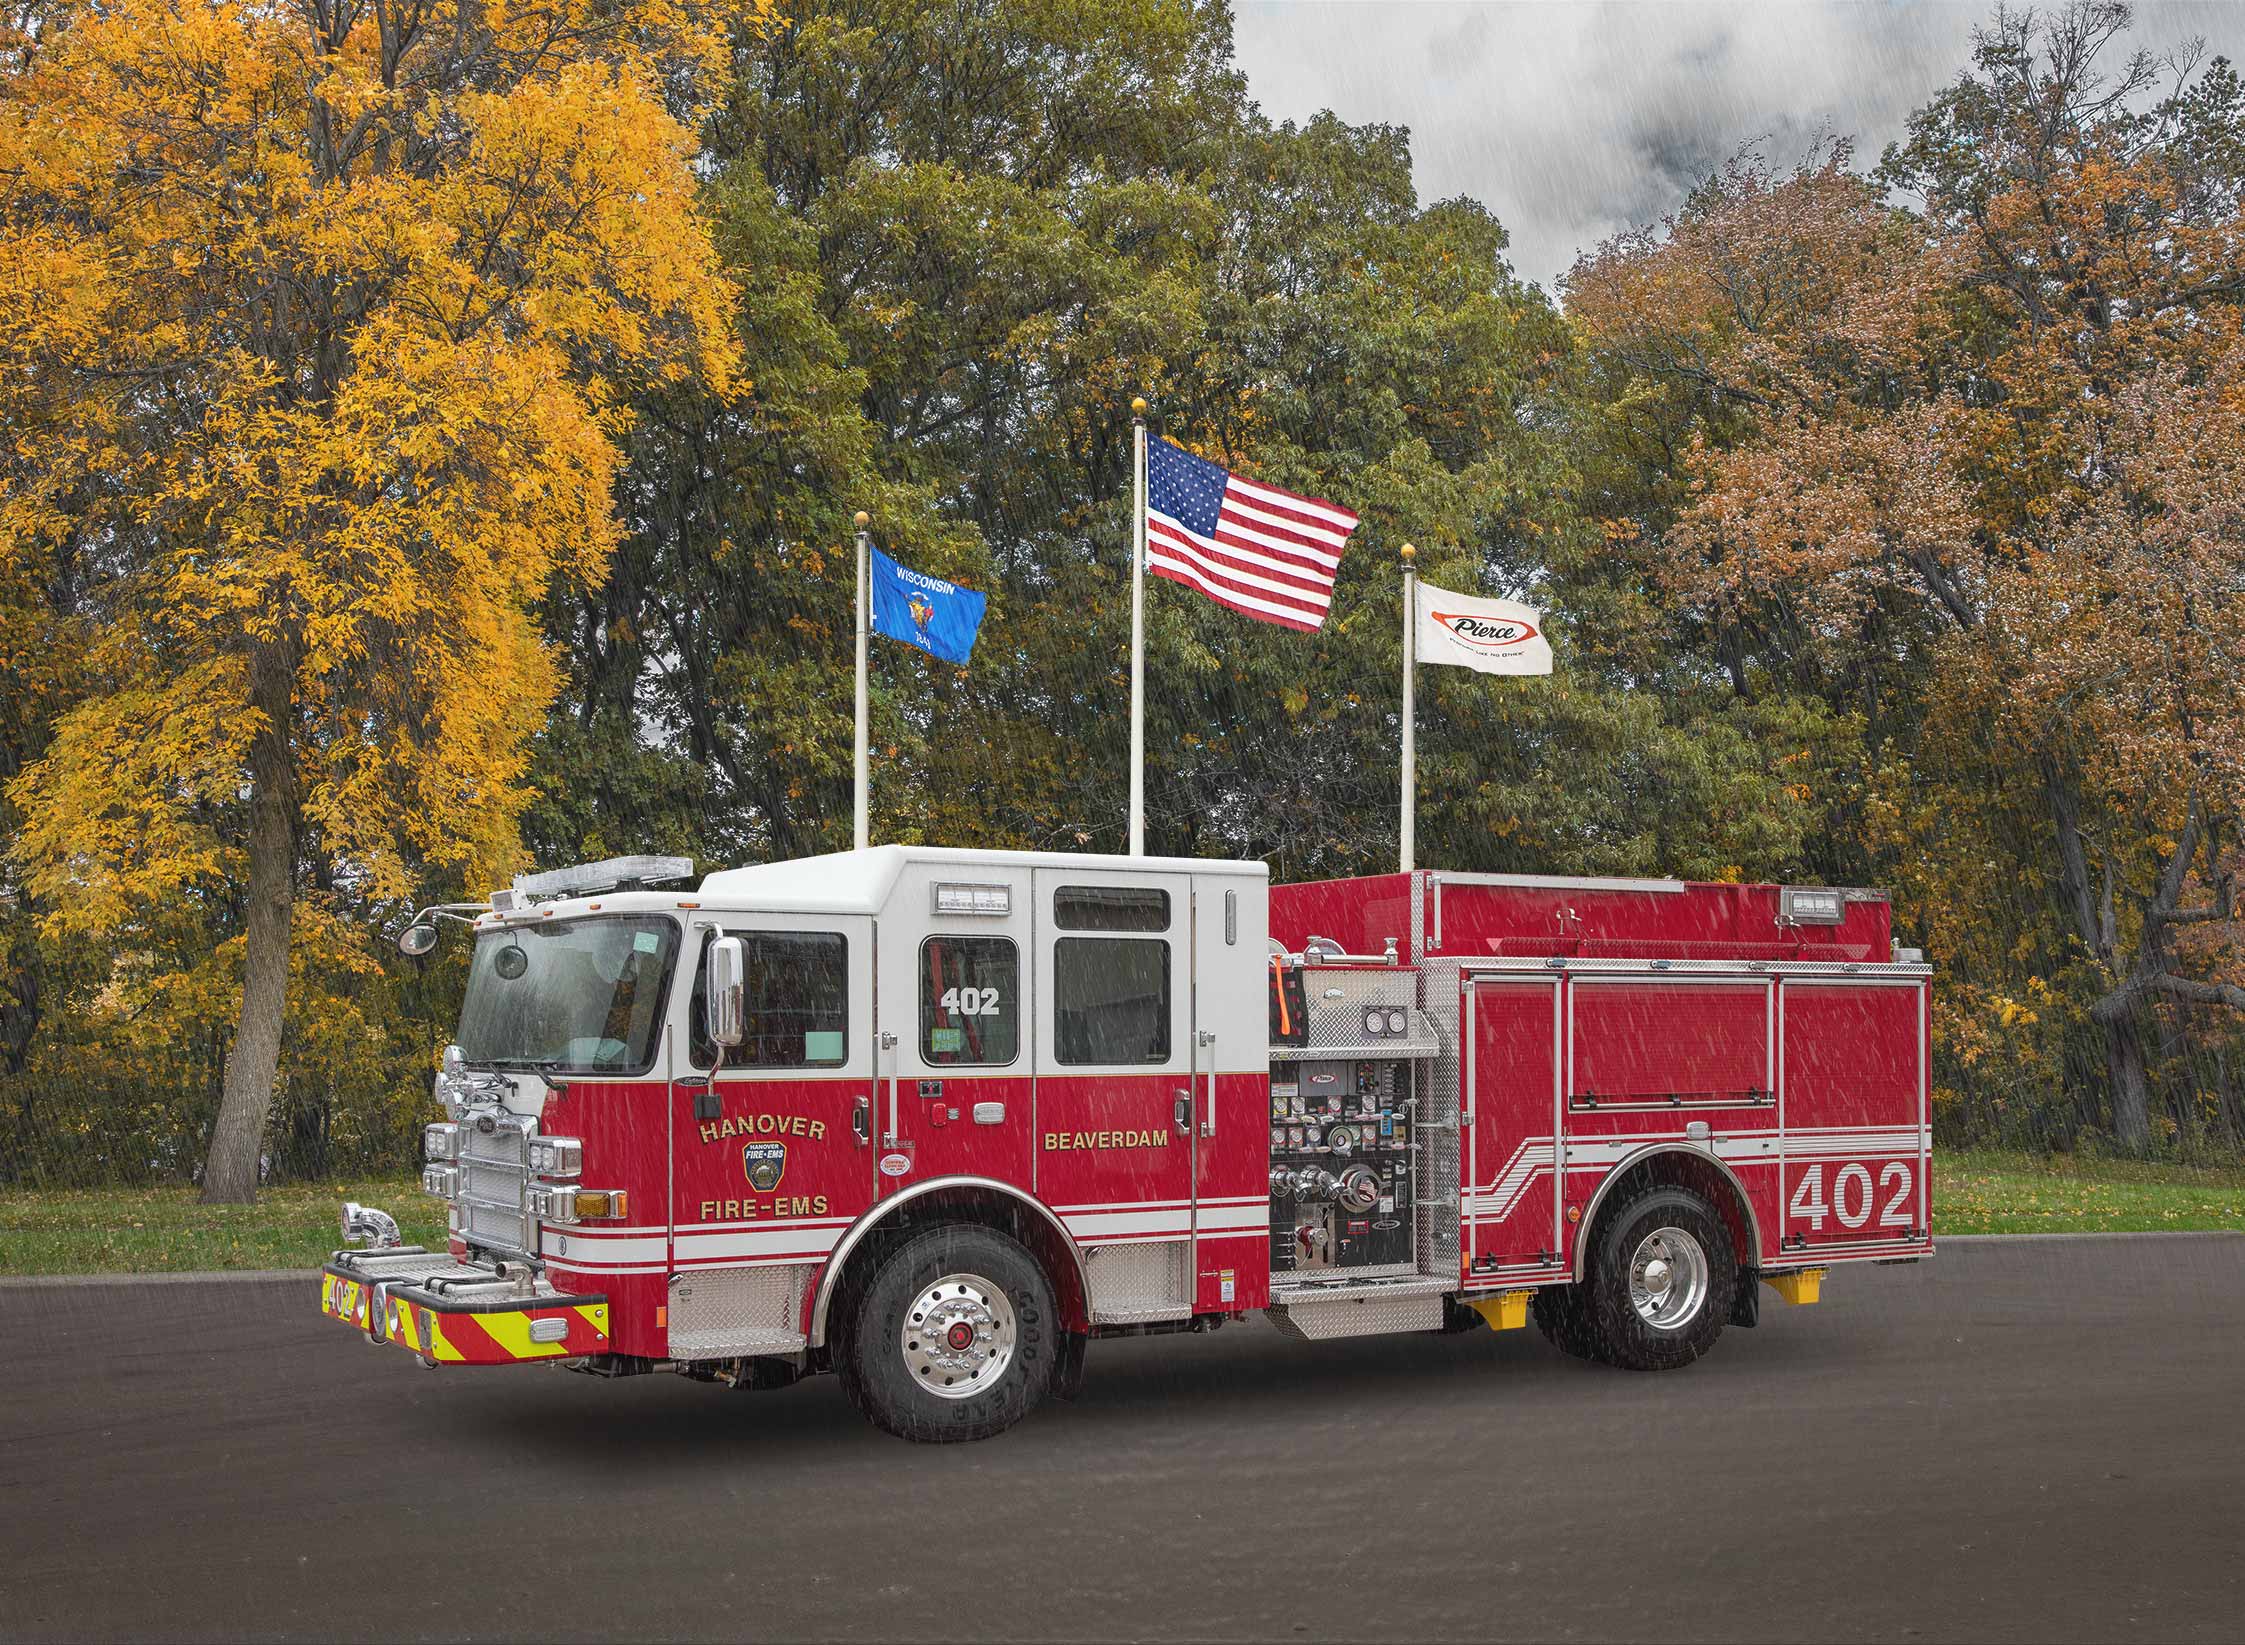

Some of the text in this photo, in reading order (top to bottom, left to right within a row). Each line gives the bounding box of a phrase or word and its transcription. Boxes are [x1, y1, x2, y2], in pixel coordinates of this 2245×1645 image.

[896, 566, 955, 595] WISCONSIN
[1454, 618, 1514, 639] Pierce
[940, 987, 1000, 1015] 402
[699, 1114, 826, 1144] HANOVER
[1044, 1129, 1168, 1151] BEAVERDAM
[700, 1195, 828, 1220] FIRE-EMS
[1790, 1161, 1913, 1230] 402
[328, 1278, 351, 1317] 402
